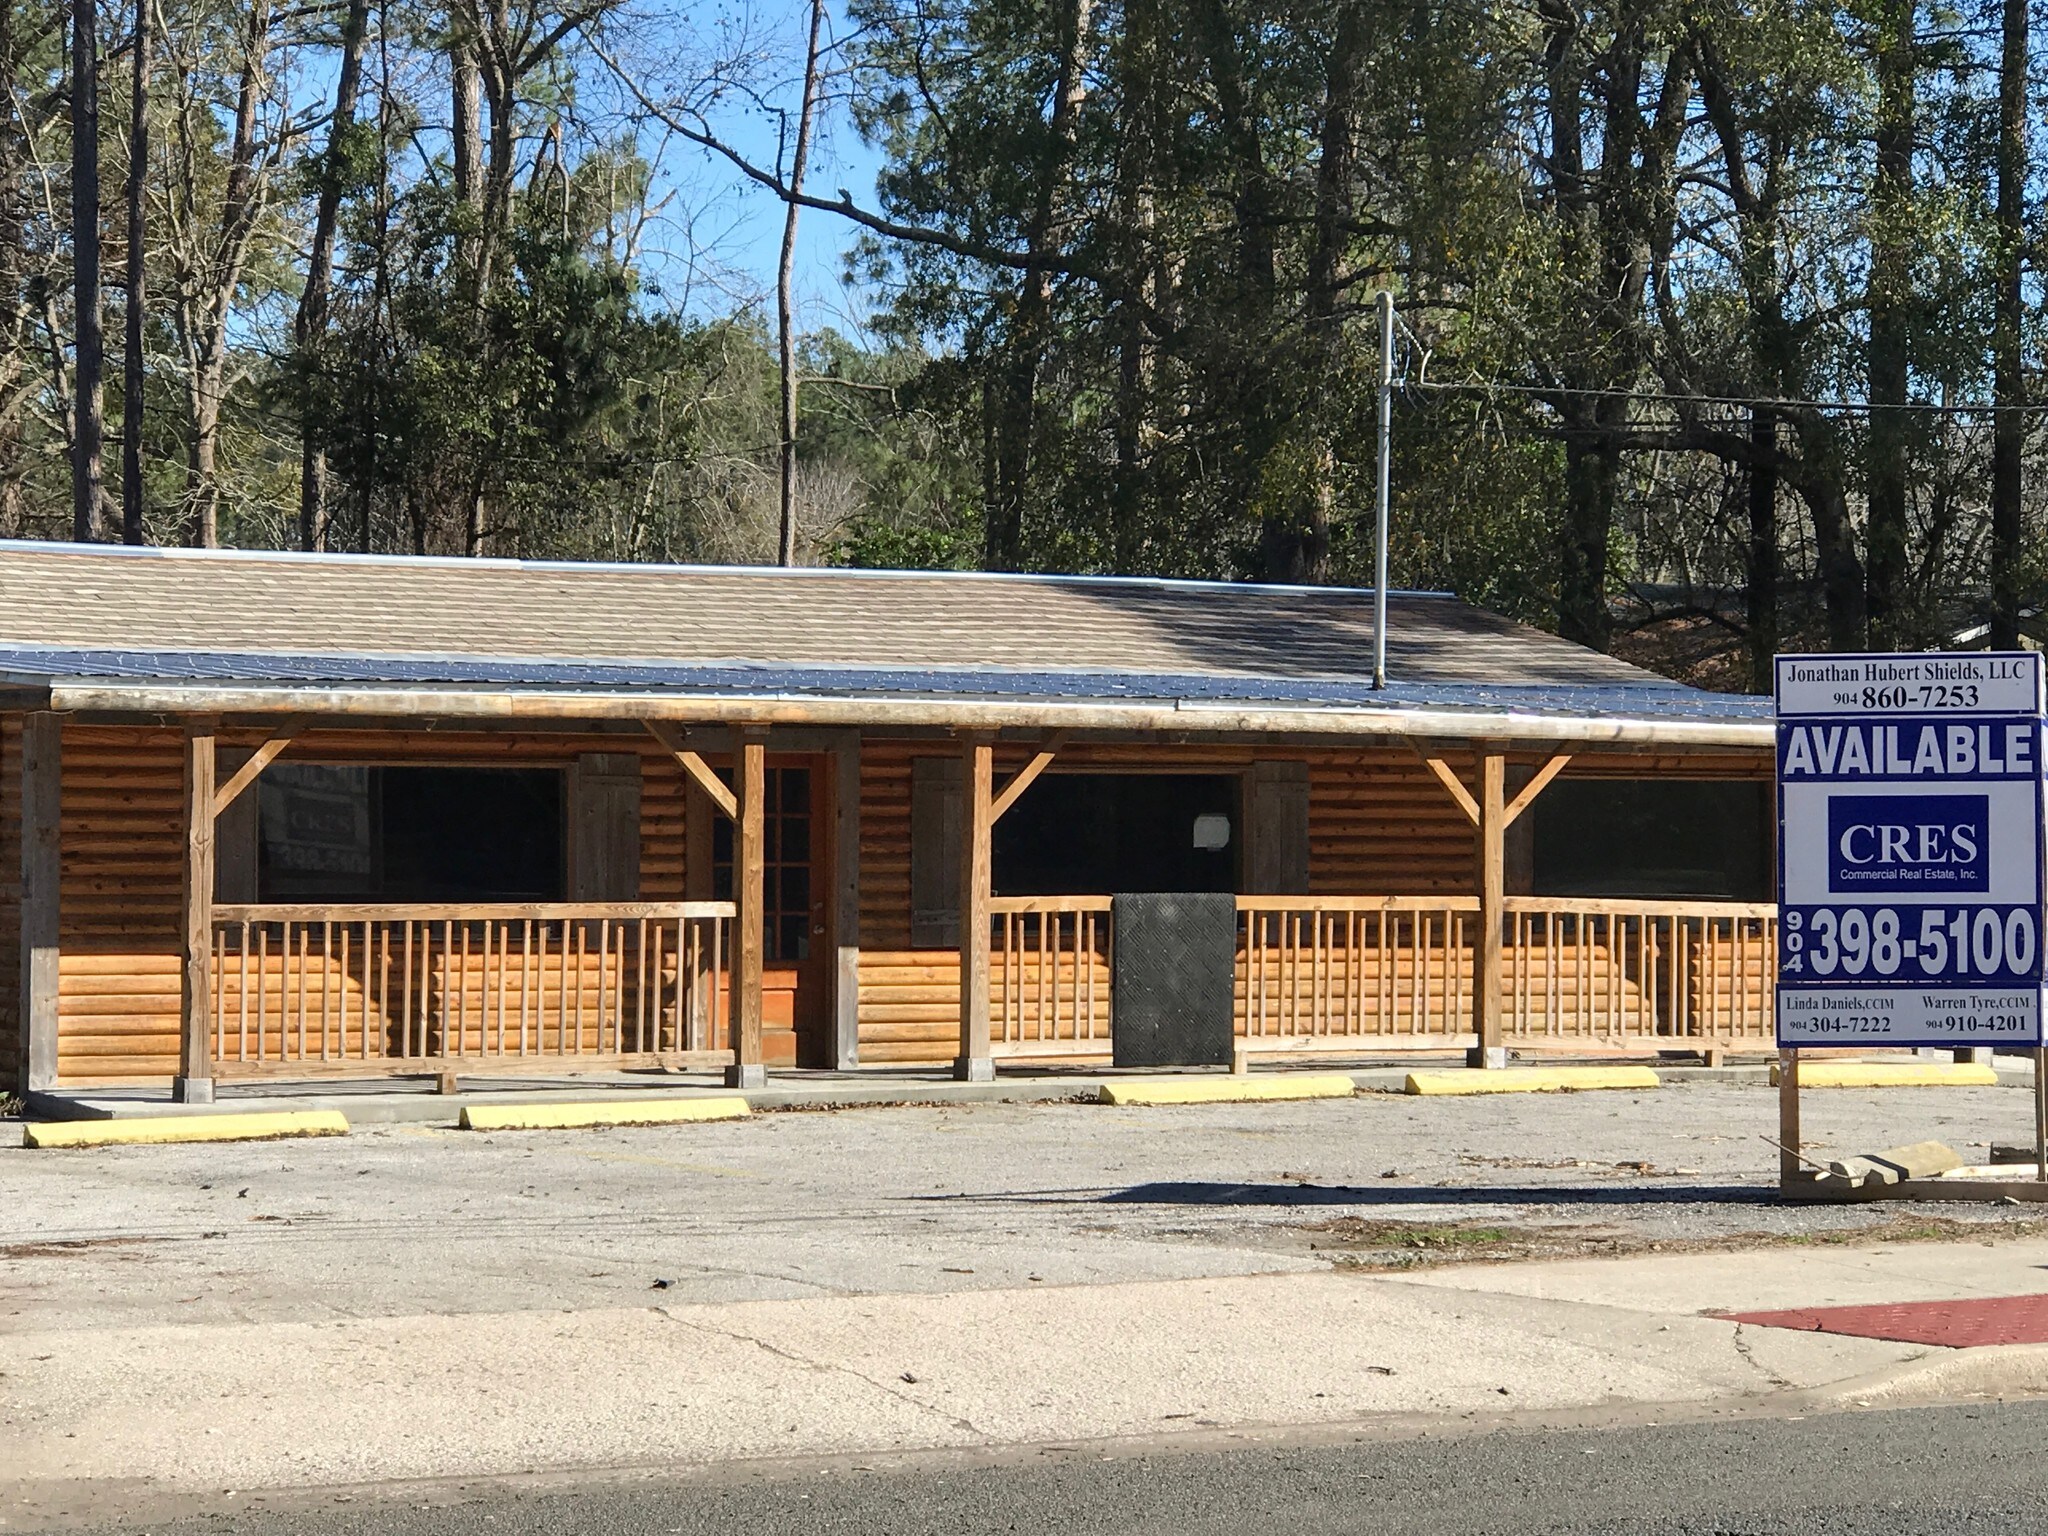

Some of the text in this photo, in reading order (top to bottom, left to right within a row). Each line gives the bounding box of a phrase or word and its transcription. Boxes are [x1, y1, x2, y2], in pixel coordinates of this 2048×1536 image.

[1787, 661, 2026, 683] Jonathan Hubert Shields, LLC
[1833, 685, 1979, 708] 904 860-7253
[1783, 724, 2033, 775] AVAILABLE
[1840, 824, 1978, 864] CRES
[1840, 868, 1978, 881] Commercial Real Estate, Inc.
[1810, 908, 2036, 975] 398-5100
[1786, 997, 1819, 1010] Linda
[1922, 996, 1967, 1009] Warren
[1790, 1016, 1891, 1032] 904 304-7222
[1926, 1015, 2026, 1032] 904 910-4201
